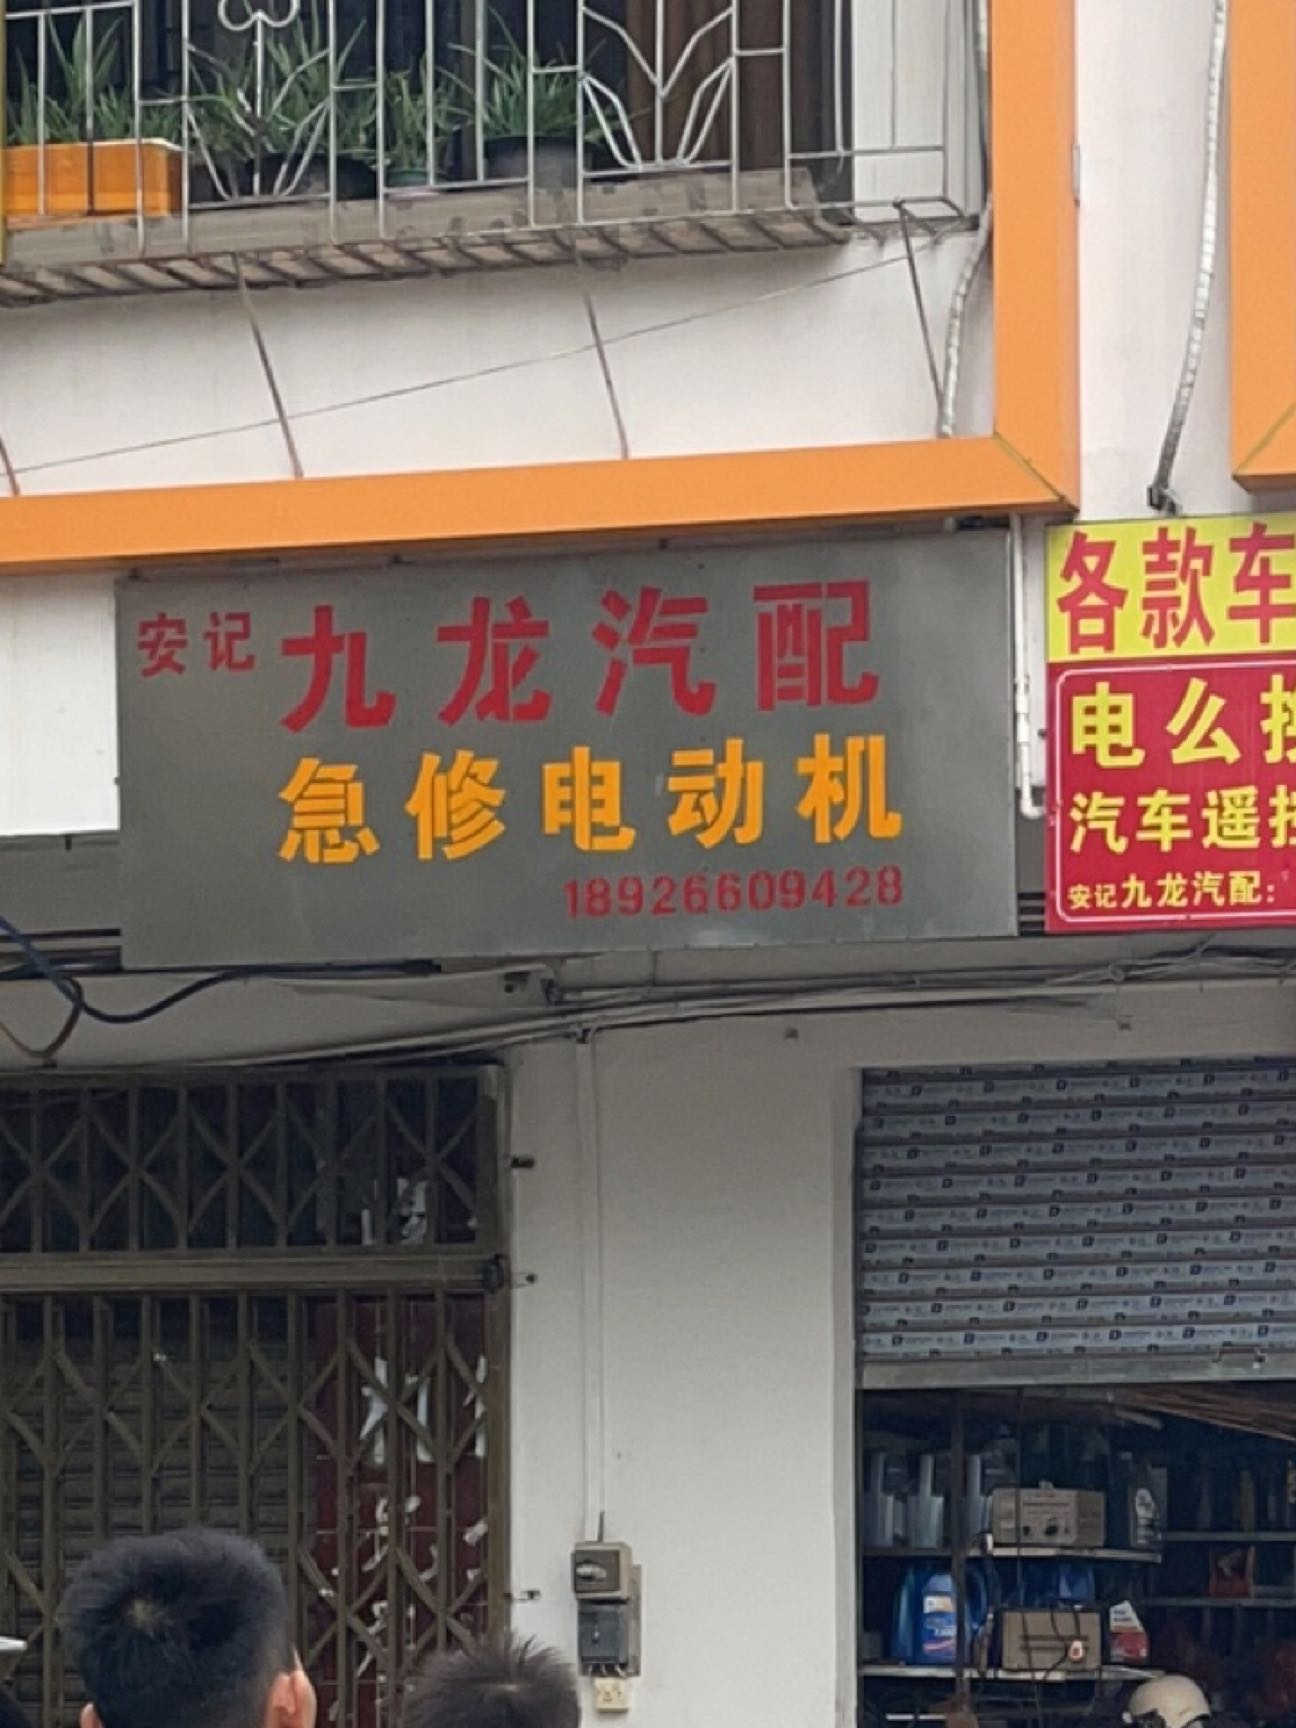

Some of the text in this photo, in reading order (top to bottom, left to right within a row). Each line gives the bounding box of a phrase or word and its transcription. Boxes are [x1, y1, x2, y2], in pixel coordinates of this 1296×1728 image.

[136, 580, 880, 733] 安记 九龙汽配
[278, 735, 904, 865] 急修电动机
[563, 865, 904, 919] 18926609428
